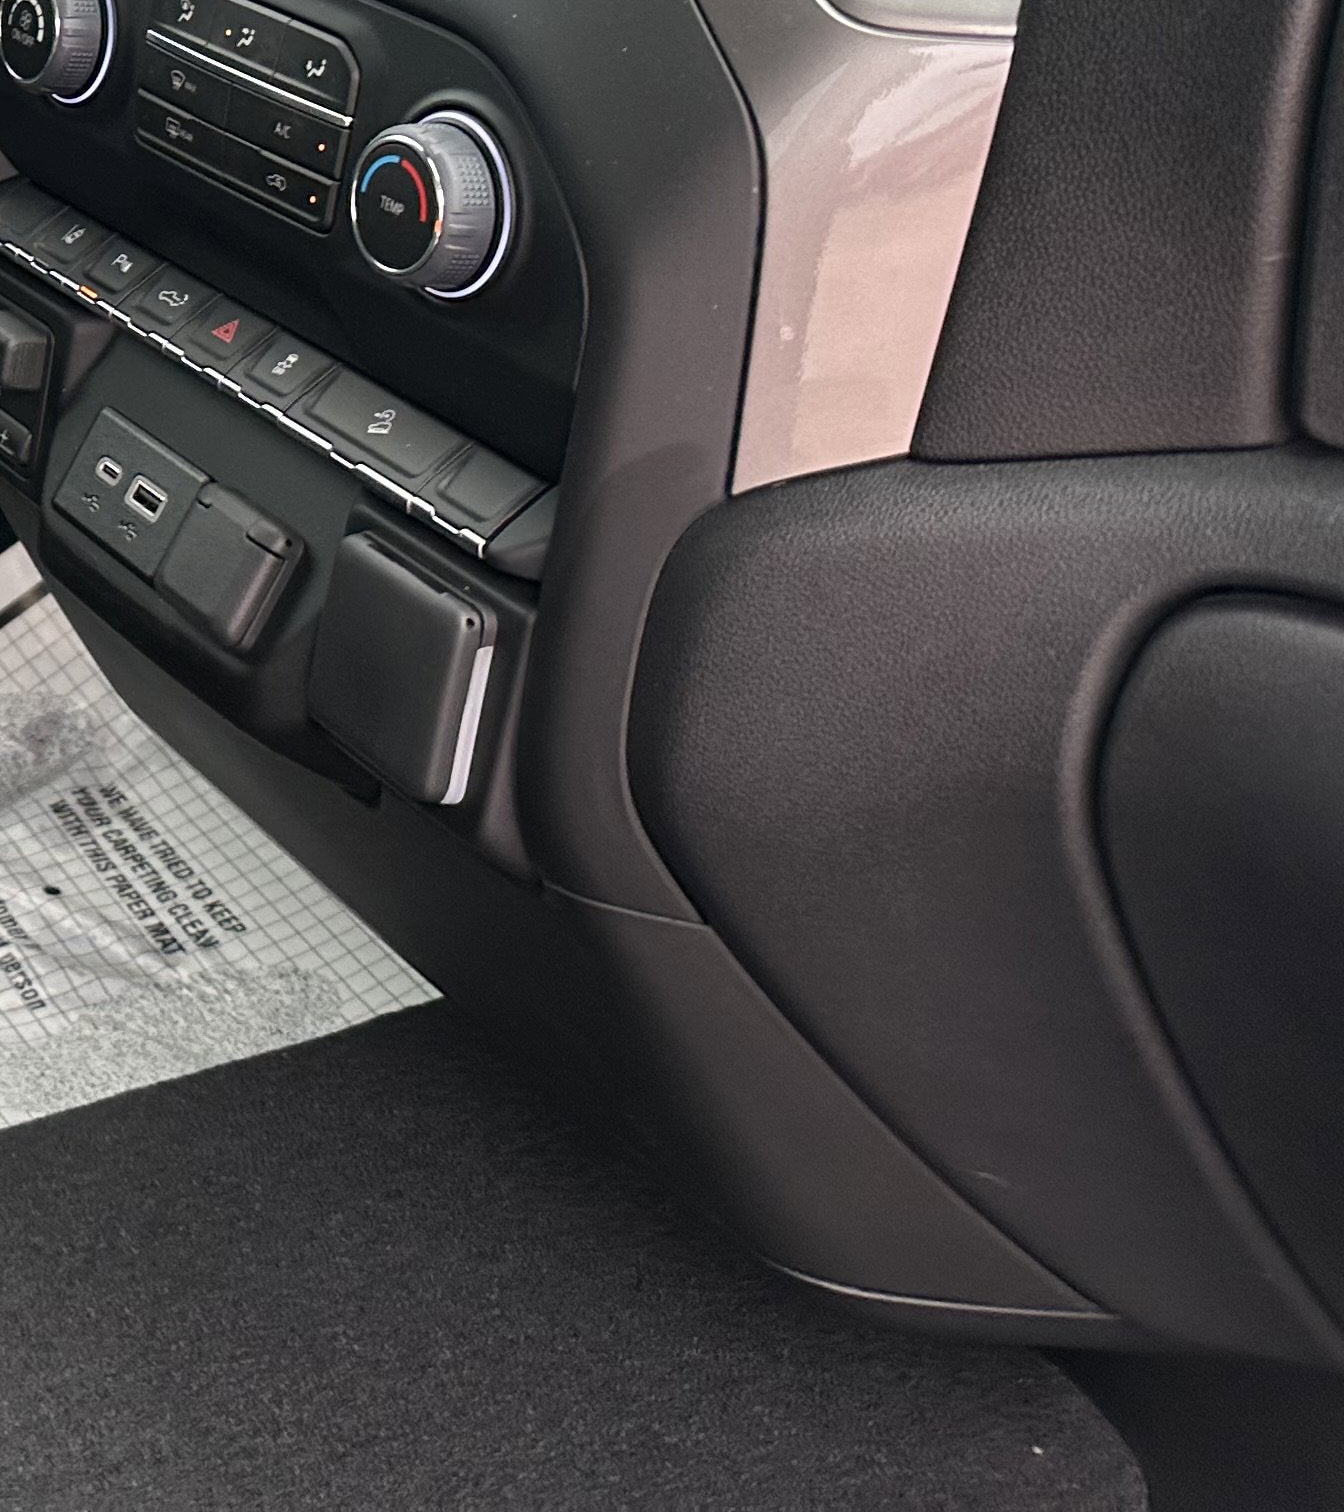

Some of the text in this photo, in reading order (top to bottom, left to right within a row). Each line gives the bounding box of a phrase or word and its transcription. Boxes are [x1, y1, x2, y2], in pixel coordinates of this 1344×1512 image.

[379, 194, 406, 216] TEMP
[49, 798, 187, 956] WITH THIS PAPER MAT
[71, 787, 111, 828] YOUR
[102, 828, 178, 904] CARPETING
[99, 782, 247, 934] WE HAVE TRIED TO KEEP
